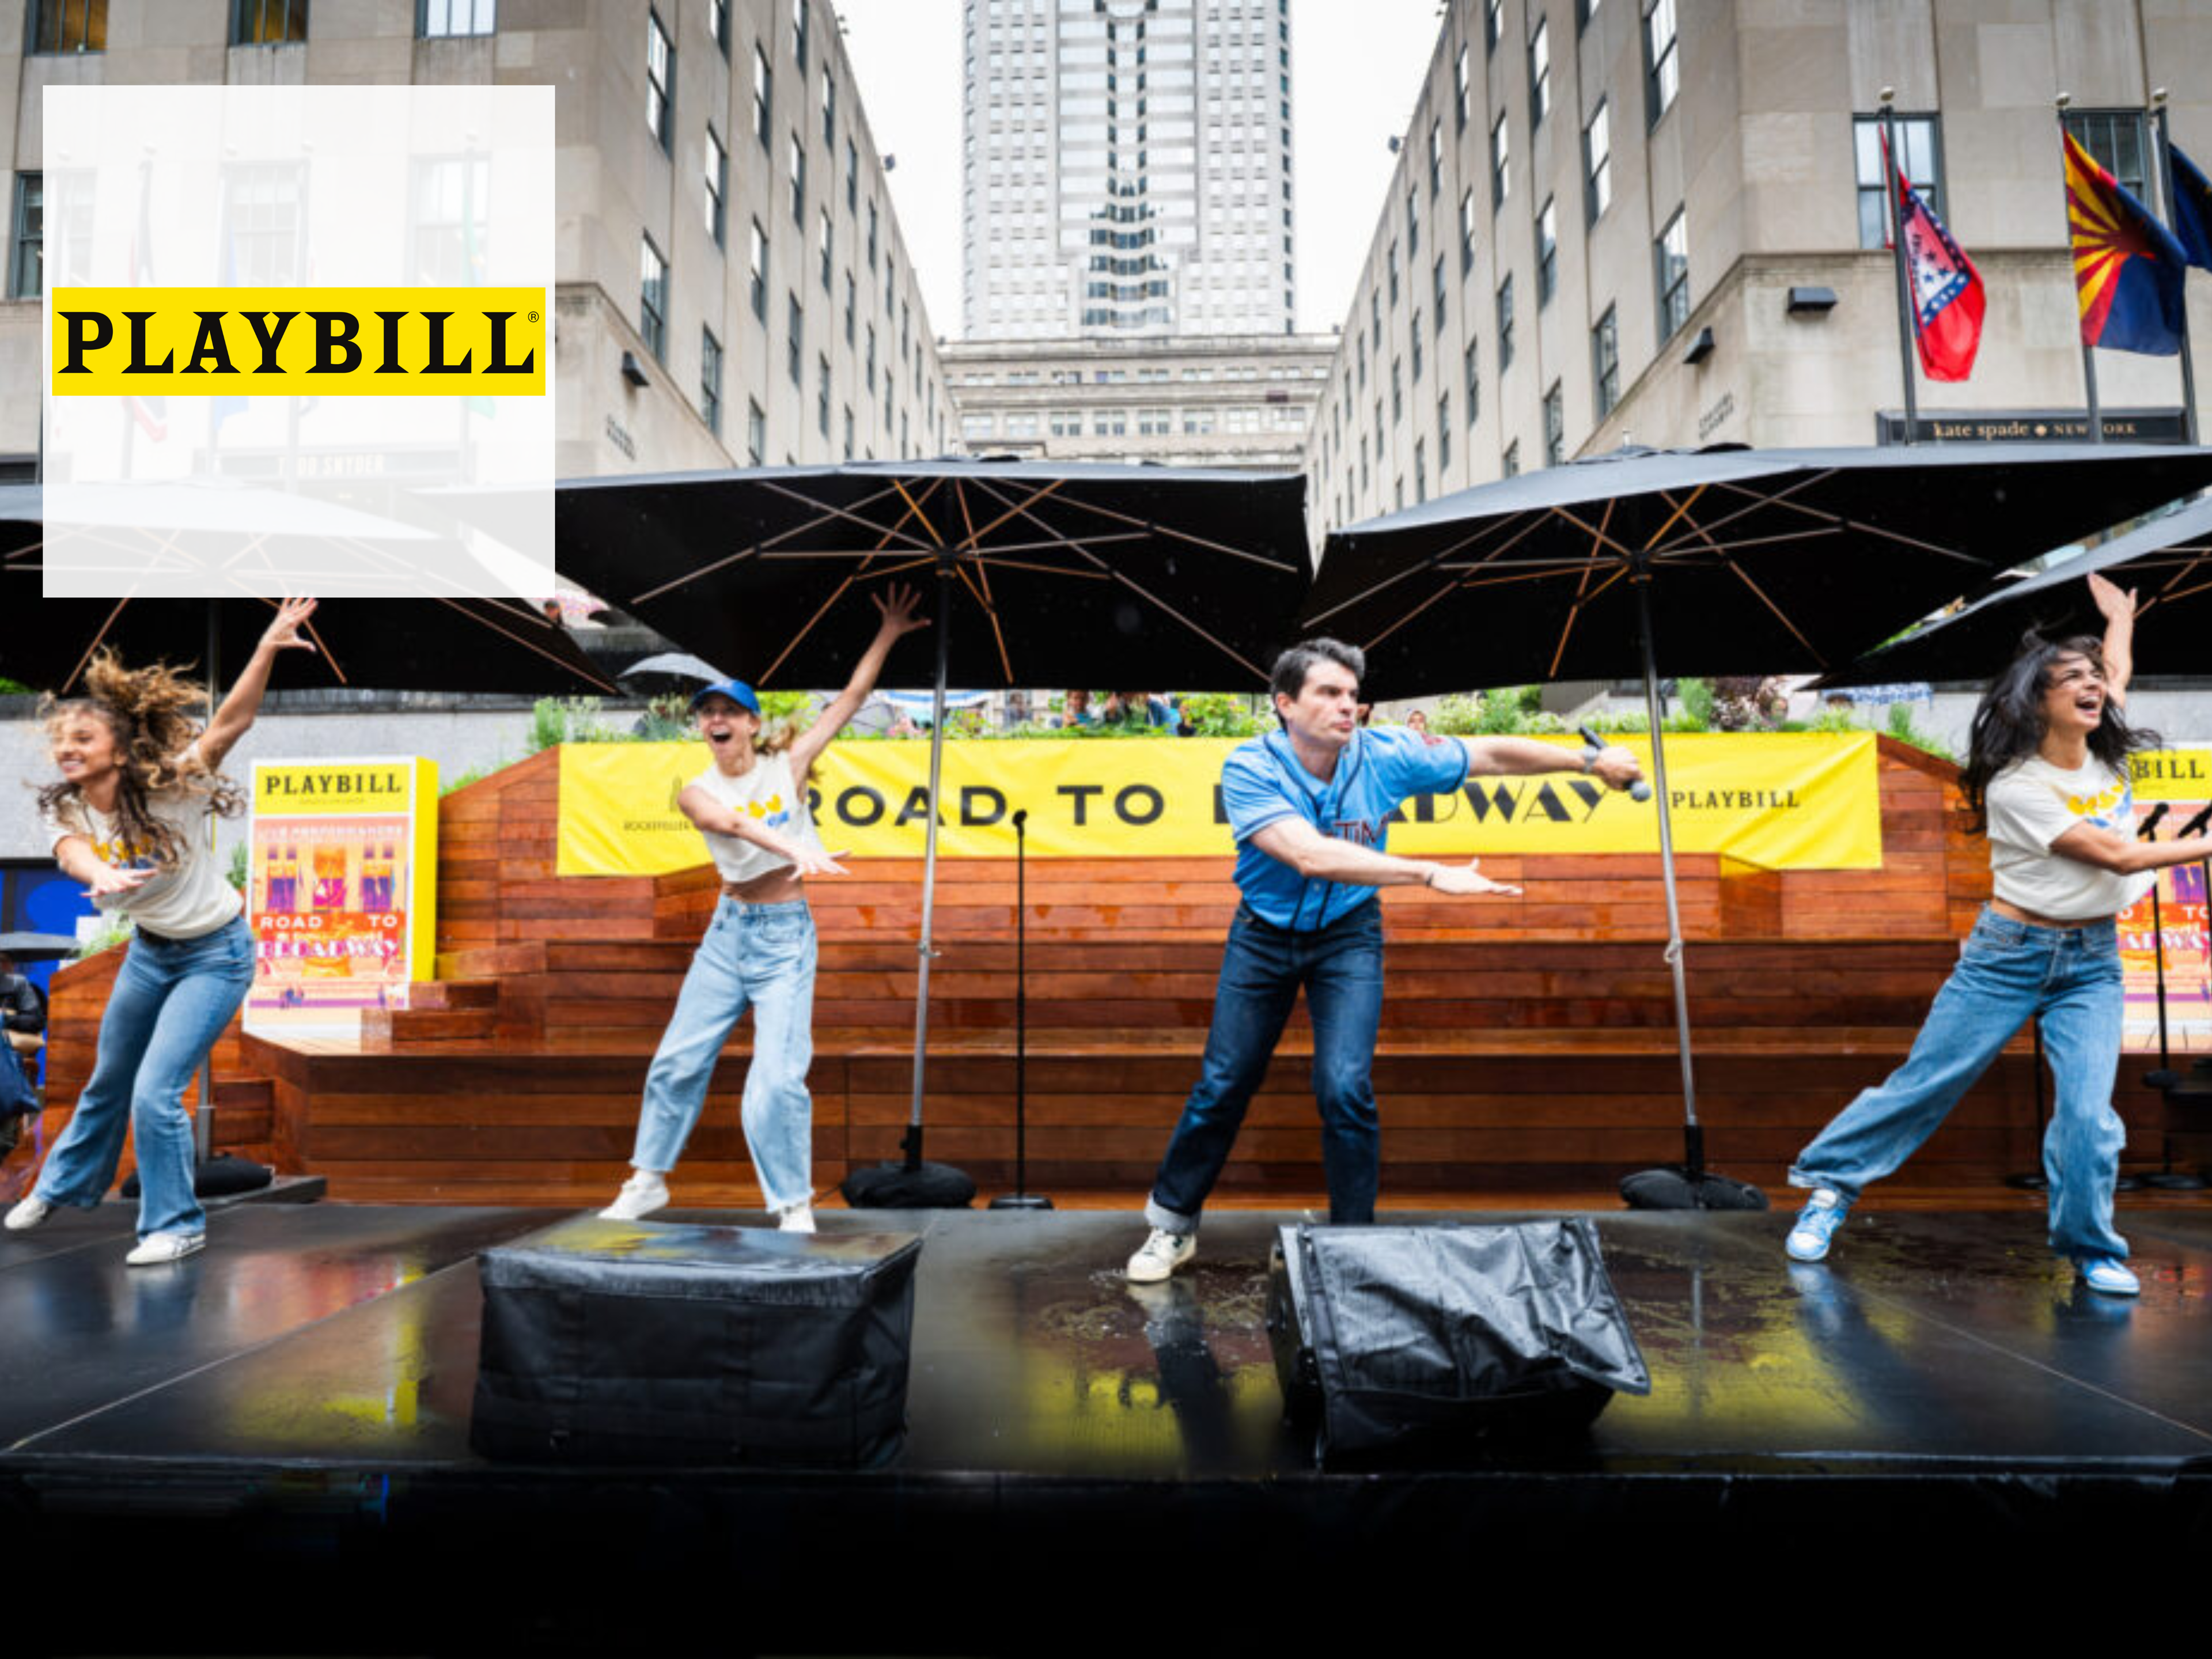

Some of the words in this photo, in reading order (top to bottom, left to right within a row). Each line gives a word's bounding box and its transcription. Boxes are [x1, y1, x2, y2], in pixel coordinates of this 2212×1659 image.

[1934, 421, 1971, 437] kate
[1977, 421, 2029, 440] spade
[2103, 423, 2137, 435] ORK
[278, 456, 317, 478] TDD
[323, 453, 384, 477] SNYDER
[2135, 759, 2205, 779] BILL
[266, 773, 402, 795] PLAYBILL
[1056, 783, 1164, 826] TO
[1671, 790, 1800, 809] PLAYBILL
[260, 915, 323, 930] ROAD
[368, 914, 397, 928] TO
[257, 939, 398, 959] BROADWAY
